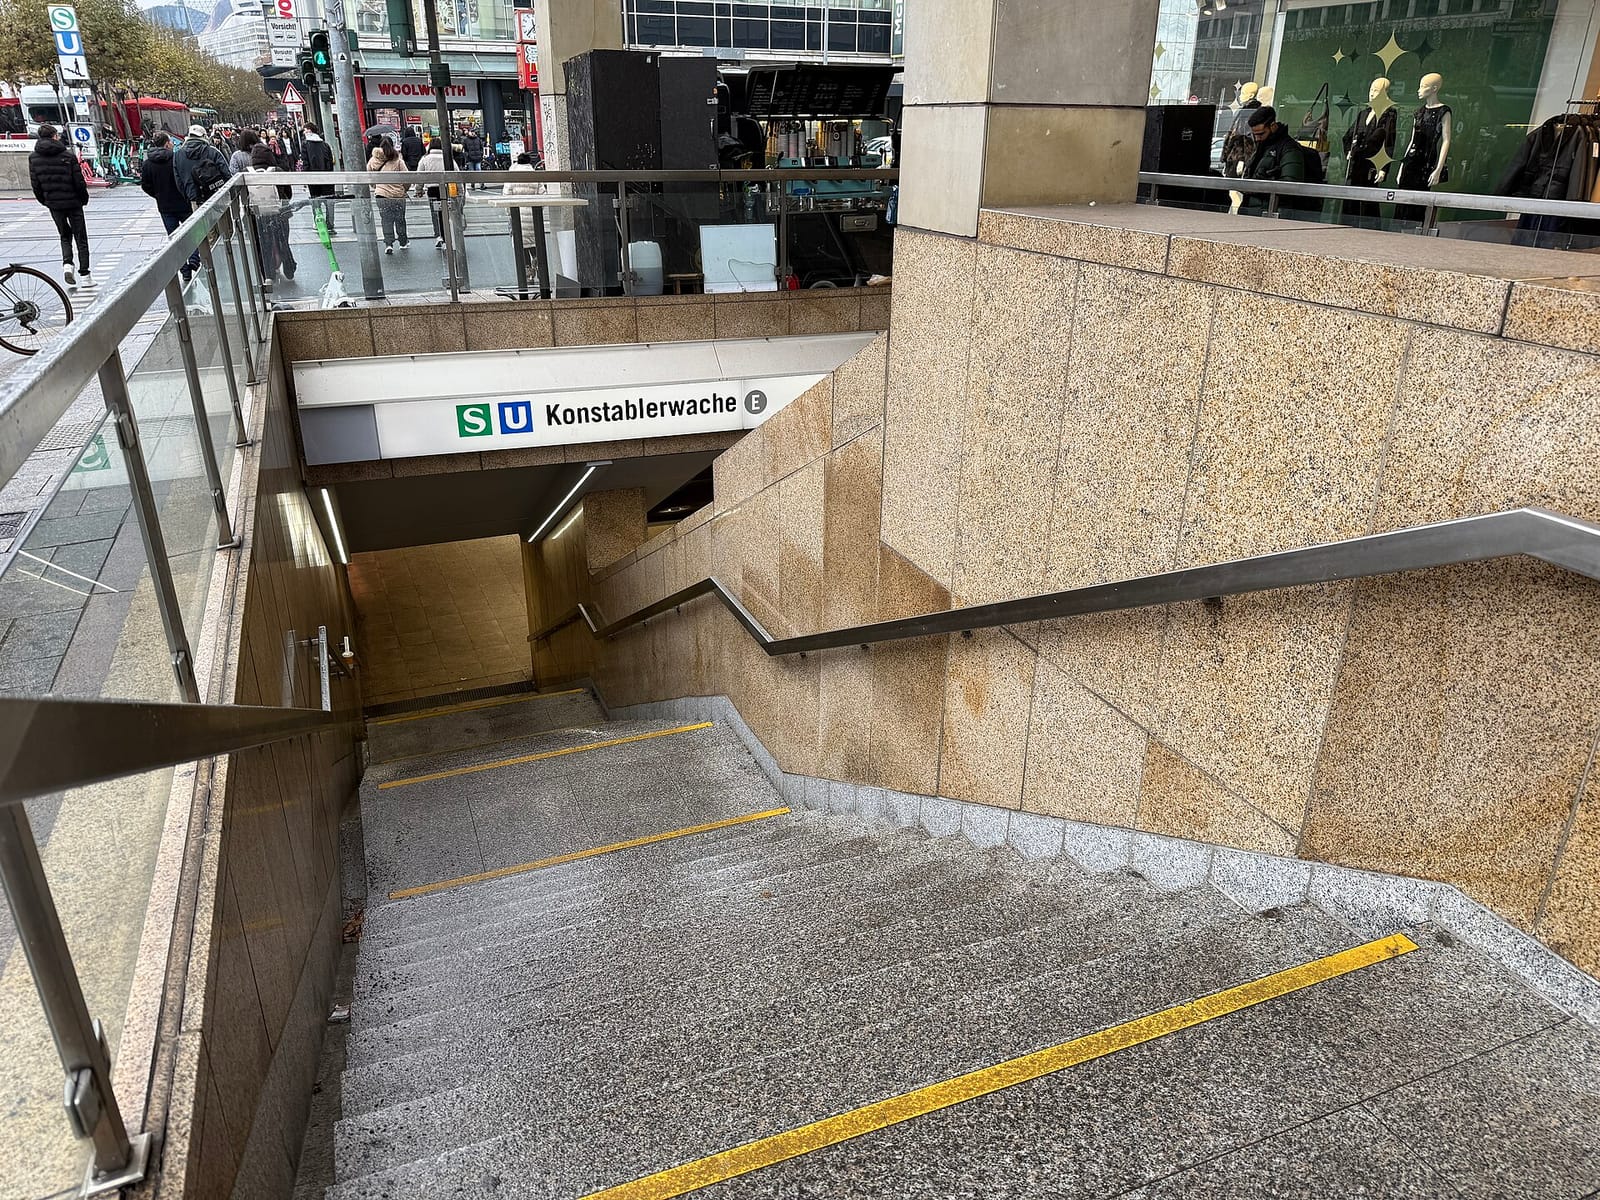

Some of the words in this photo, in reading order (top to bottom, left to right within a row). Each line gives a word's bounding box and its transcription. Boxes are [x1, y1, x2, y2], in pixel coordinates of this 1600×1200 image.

[54, 8, 73, 29] S
[56, 33, 80, 54] U
[463, 406, 487, 434] S
[503, 404, 529, 430] U
[546, 393, 738, 426] Konstablerwache
[750, 394, 761, 411] E
